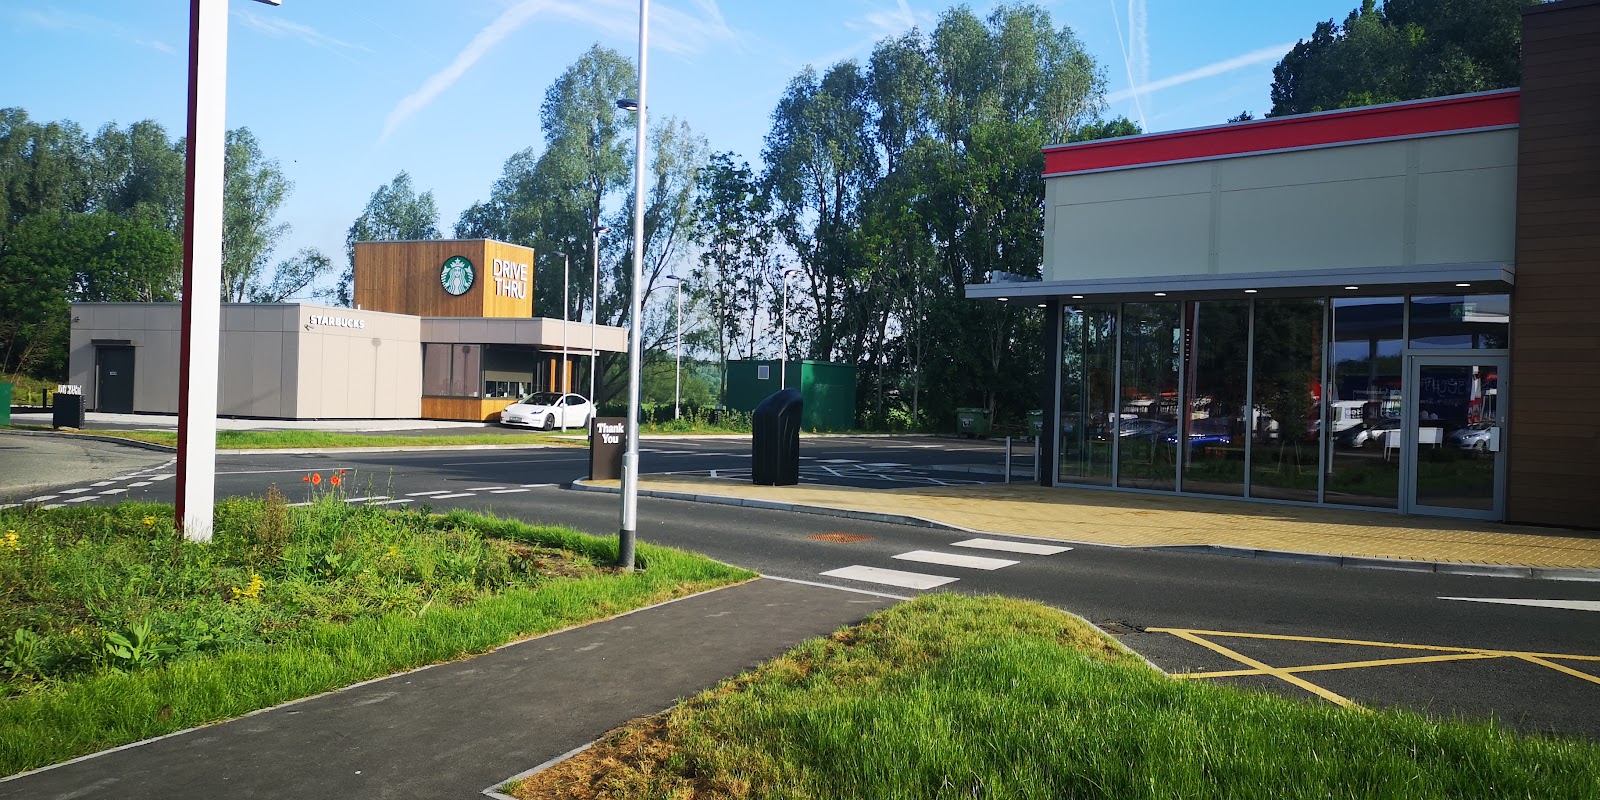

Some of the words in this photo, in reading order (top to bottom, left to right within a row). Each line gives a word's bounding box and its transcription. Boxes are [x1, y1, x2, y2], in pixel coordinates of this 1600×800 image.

[493, 259, 528, 281] DRIVE
[494, 278, 526, 299] THRU
[310, 315, 365, 329] STARBUCKS
[597, 423, 624, 434] Thank
[602, 434, 619, 444] You
